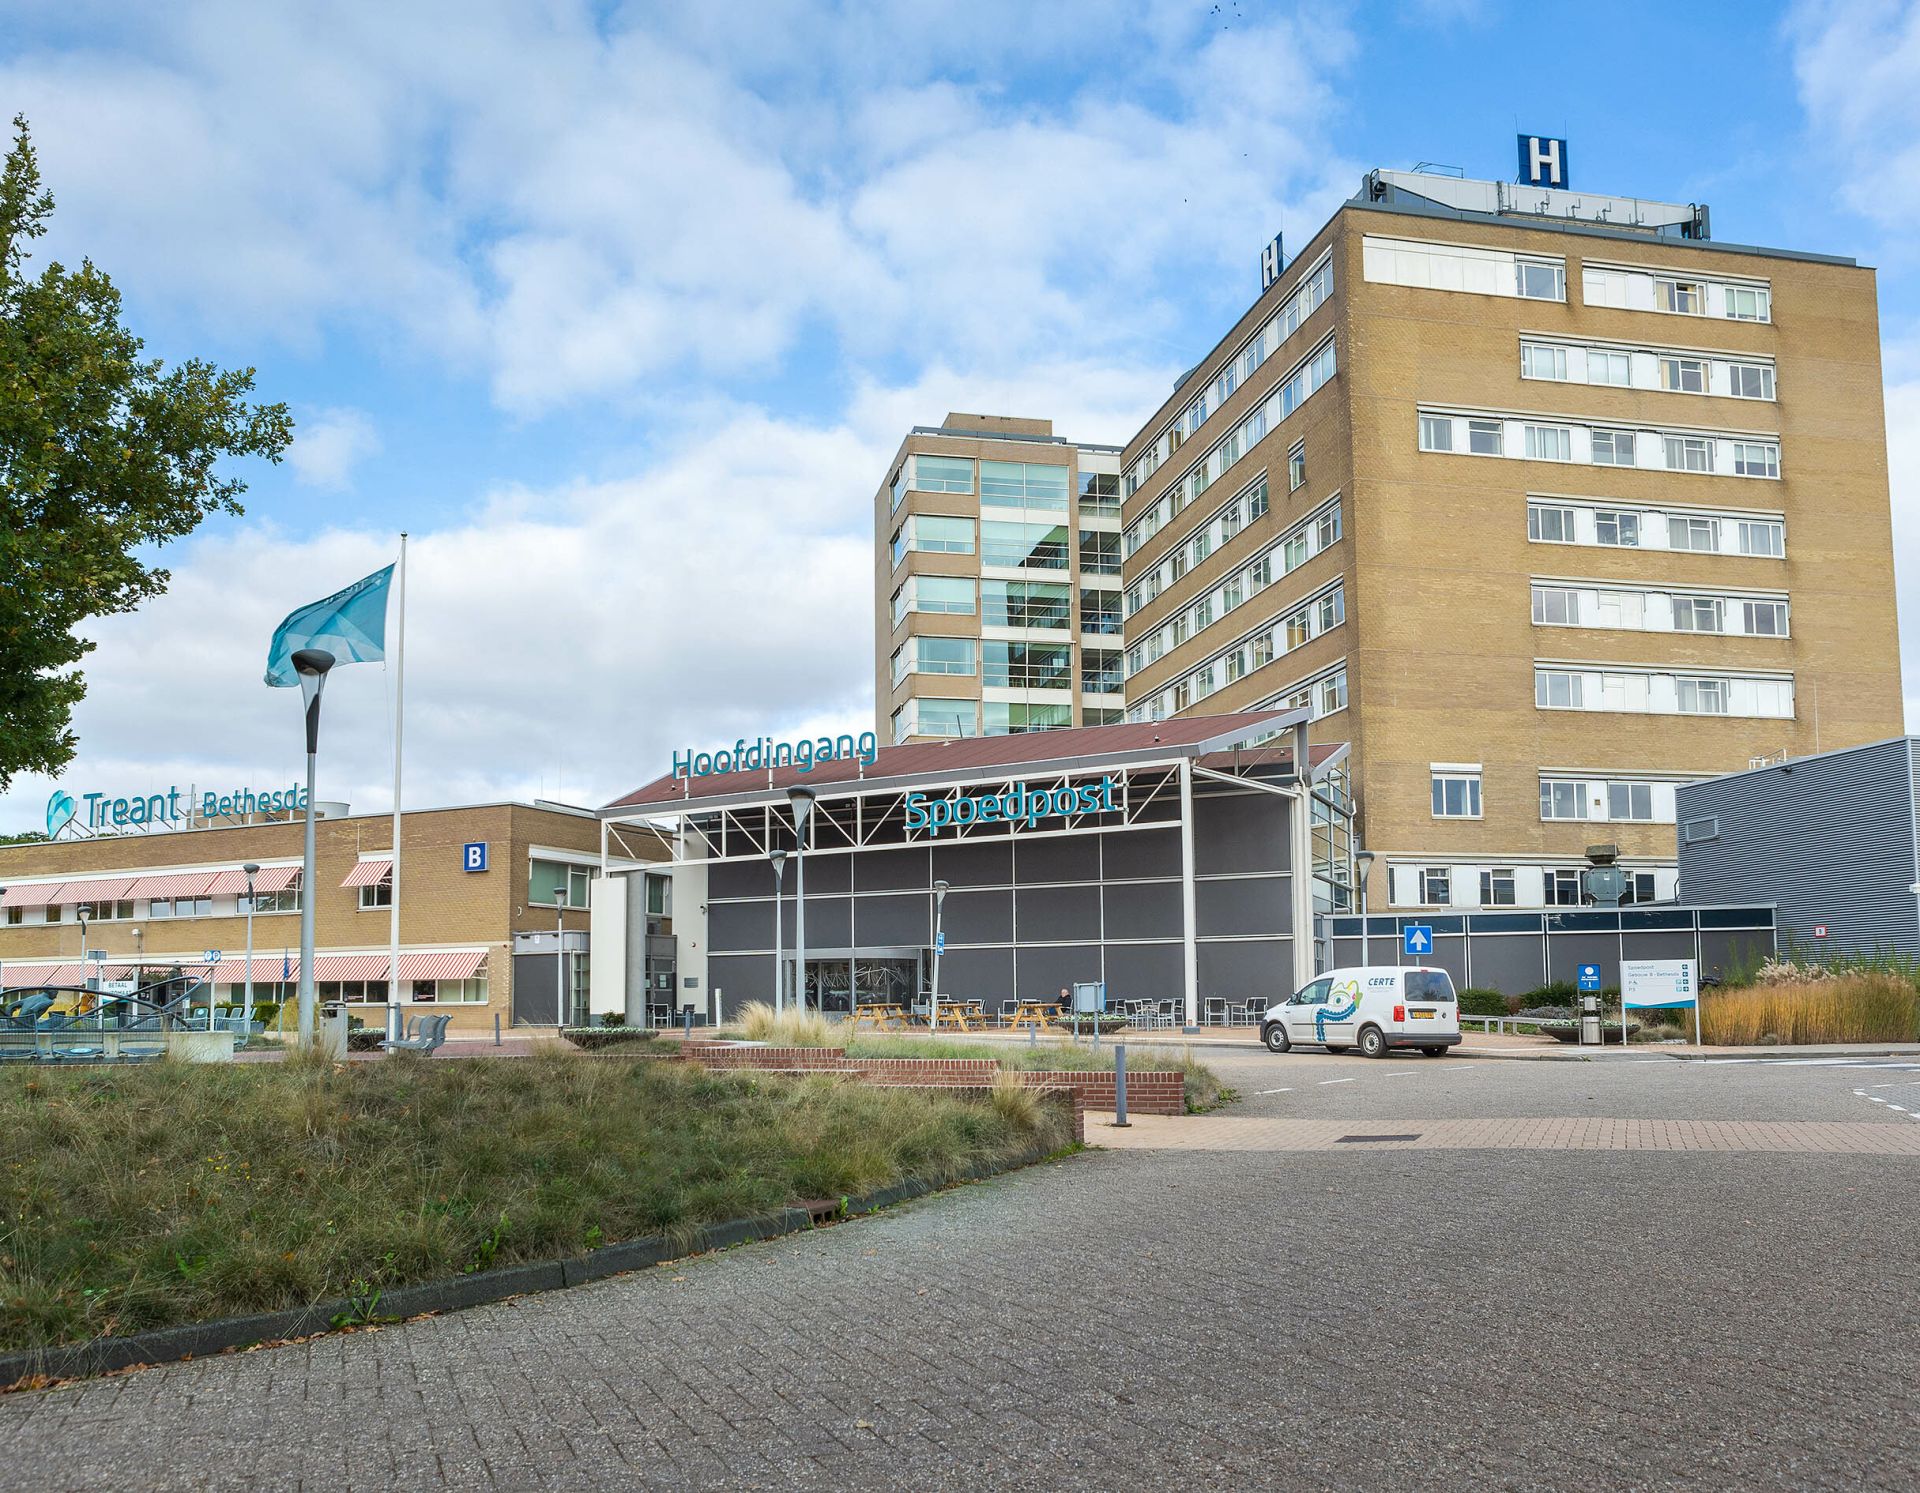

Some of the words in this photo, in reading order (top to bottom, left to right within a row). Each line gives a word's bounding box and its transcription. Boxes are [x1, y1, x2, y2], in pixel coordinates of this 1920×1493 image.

[1529, 137, 1560, 183] H
[1262, 239, 1279, 289] H
[672, 731, 879, 779] Hoofdingang
[83, 785, 182, 828] Treant
[906, 775, 1116, 837] Spoedpost
[468, 846, 481, 868] B
[1368, 977, 1396, 986] CERTE
